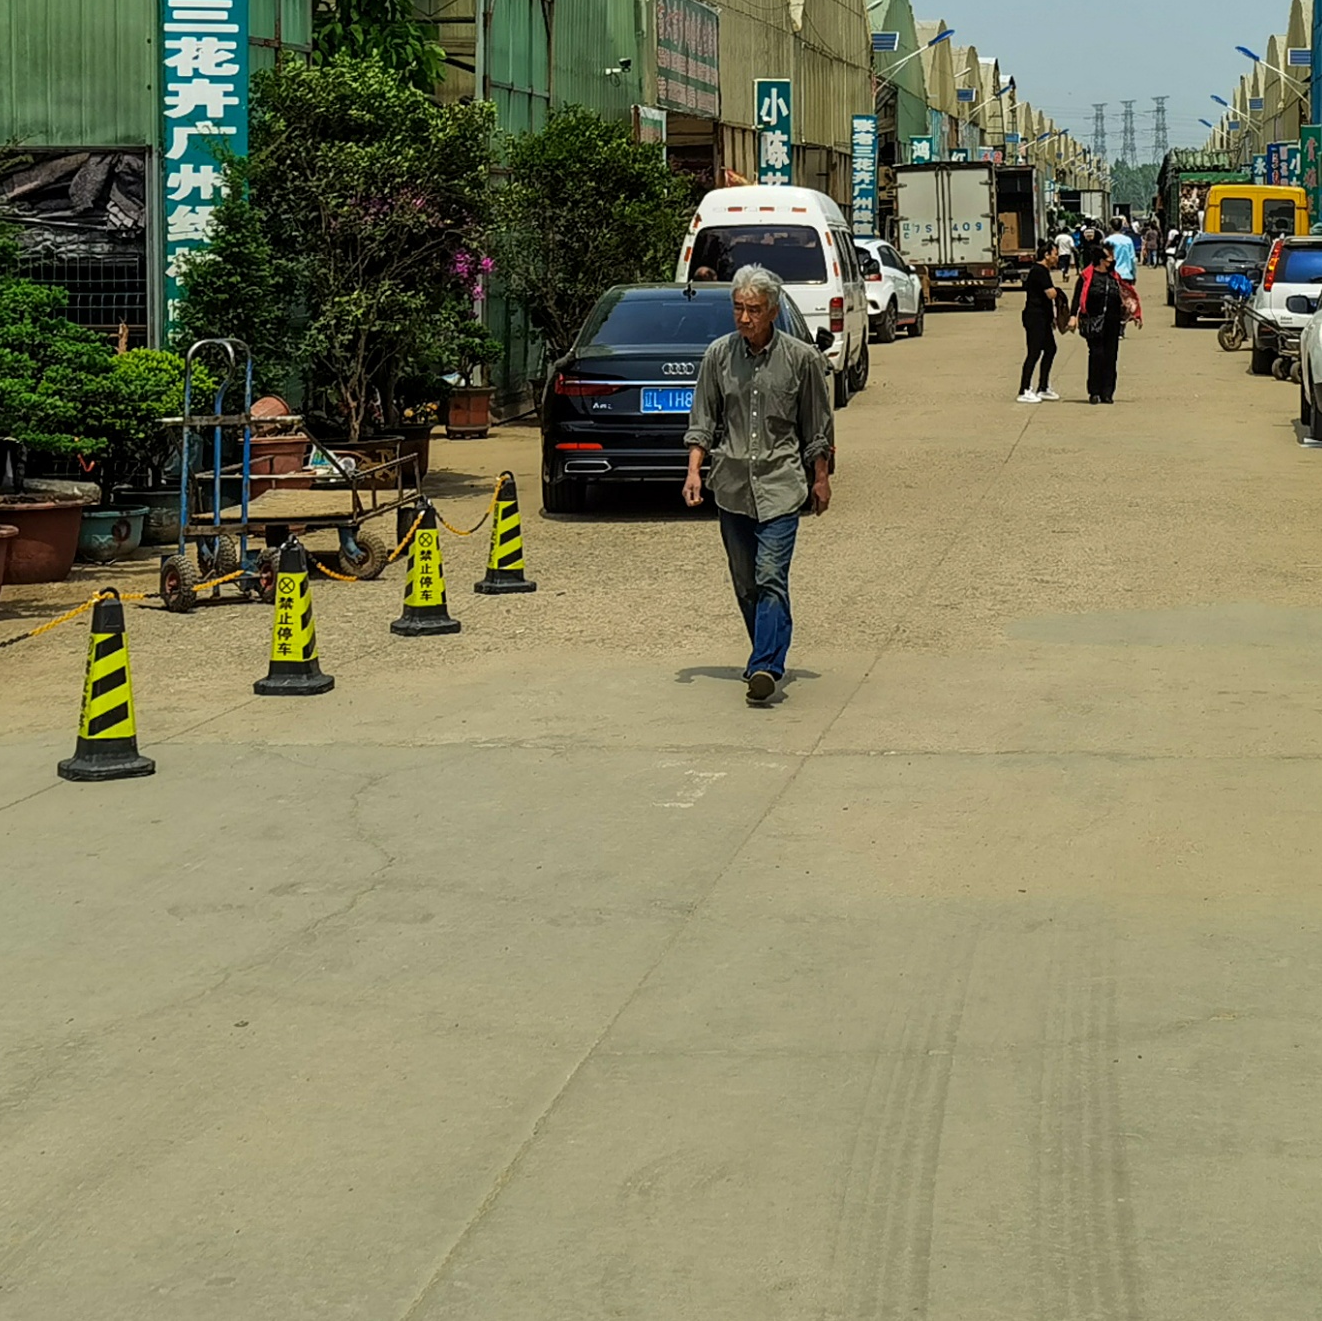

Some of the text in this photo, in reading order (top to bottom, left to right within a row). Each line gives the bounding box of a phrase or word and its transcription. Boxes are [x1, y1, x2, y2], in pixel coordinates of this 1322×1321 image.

[419, 550, 433, 601] 禁止停车
[276, 596, 294, 656] 禁止停车
